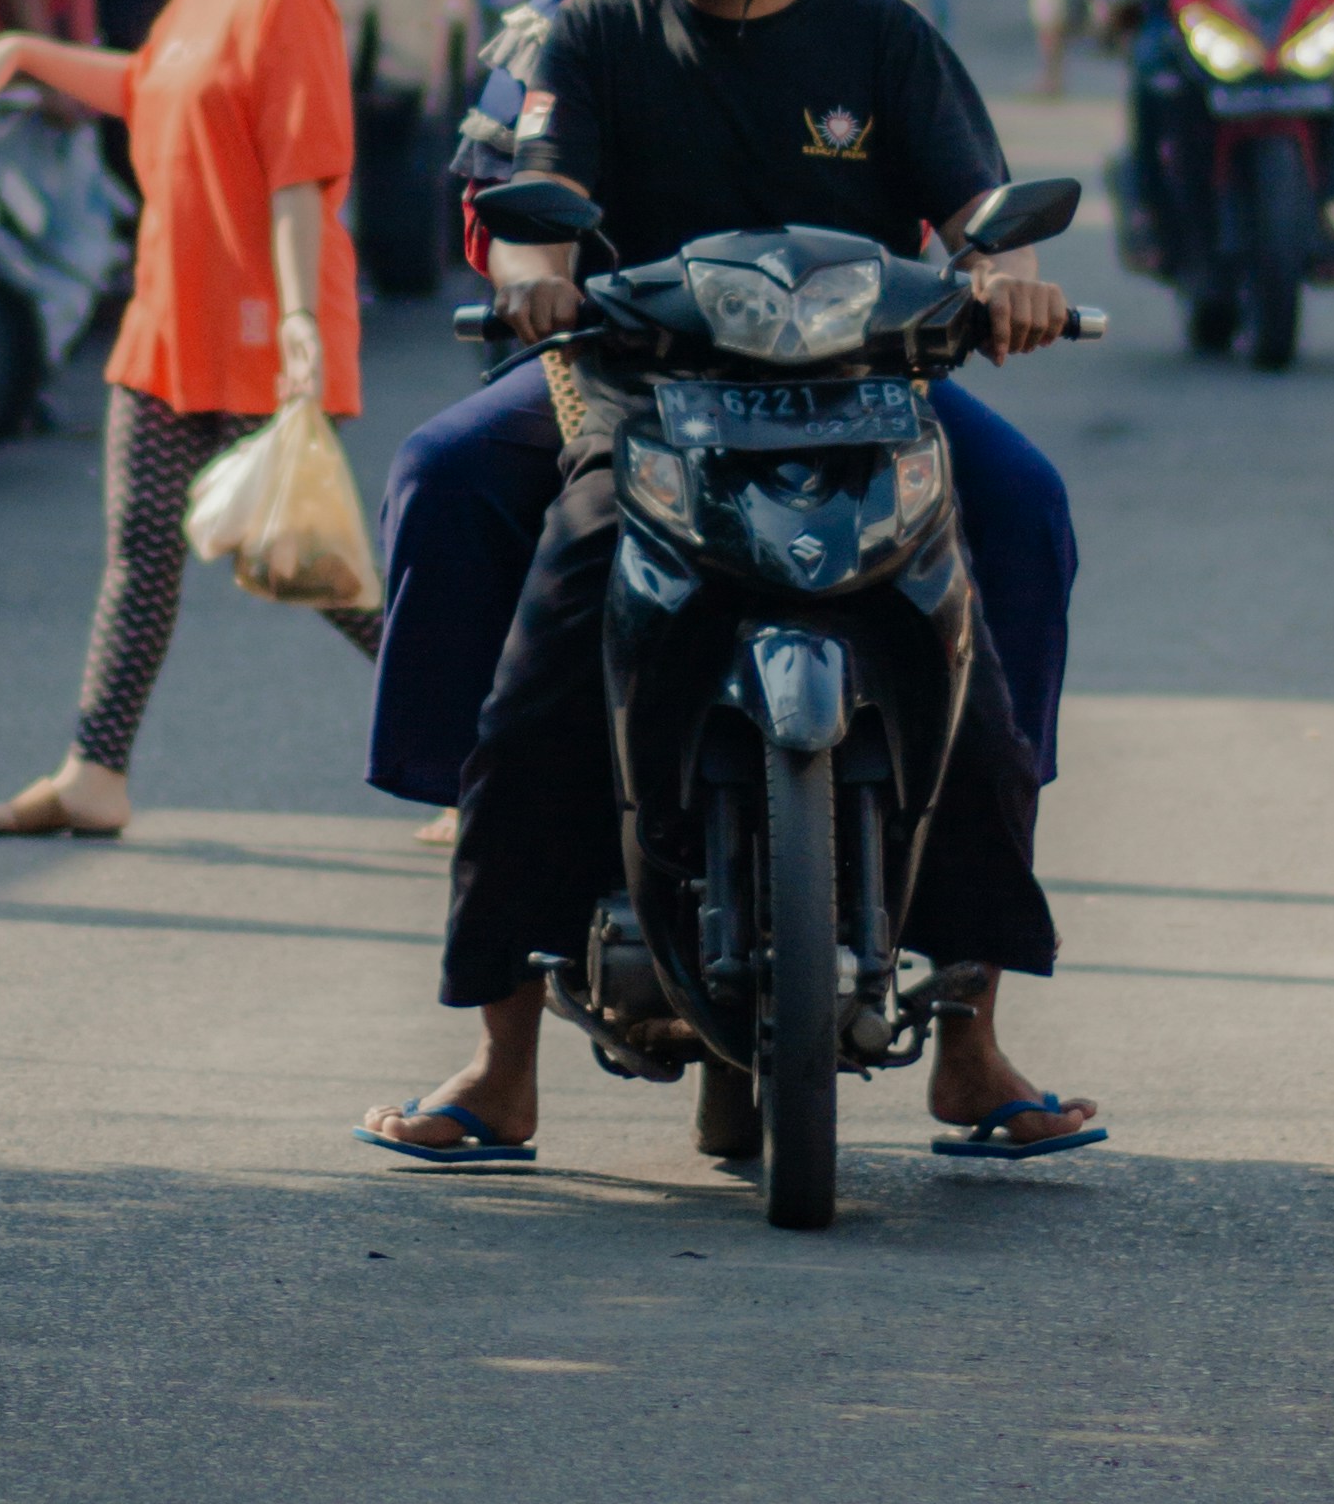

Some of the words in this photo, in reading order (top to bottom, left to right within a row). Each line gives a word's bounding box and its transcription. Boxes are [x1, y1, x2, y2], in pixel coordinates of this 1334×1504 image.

[667, 389, 688, 414] N
[723, 388, 816, 415] 6221
[859, 383, 906, 407] FB
